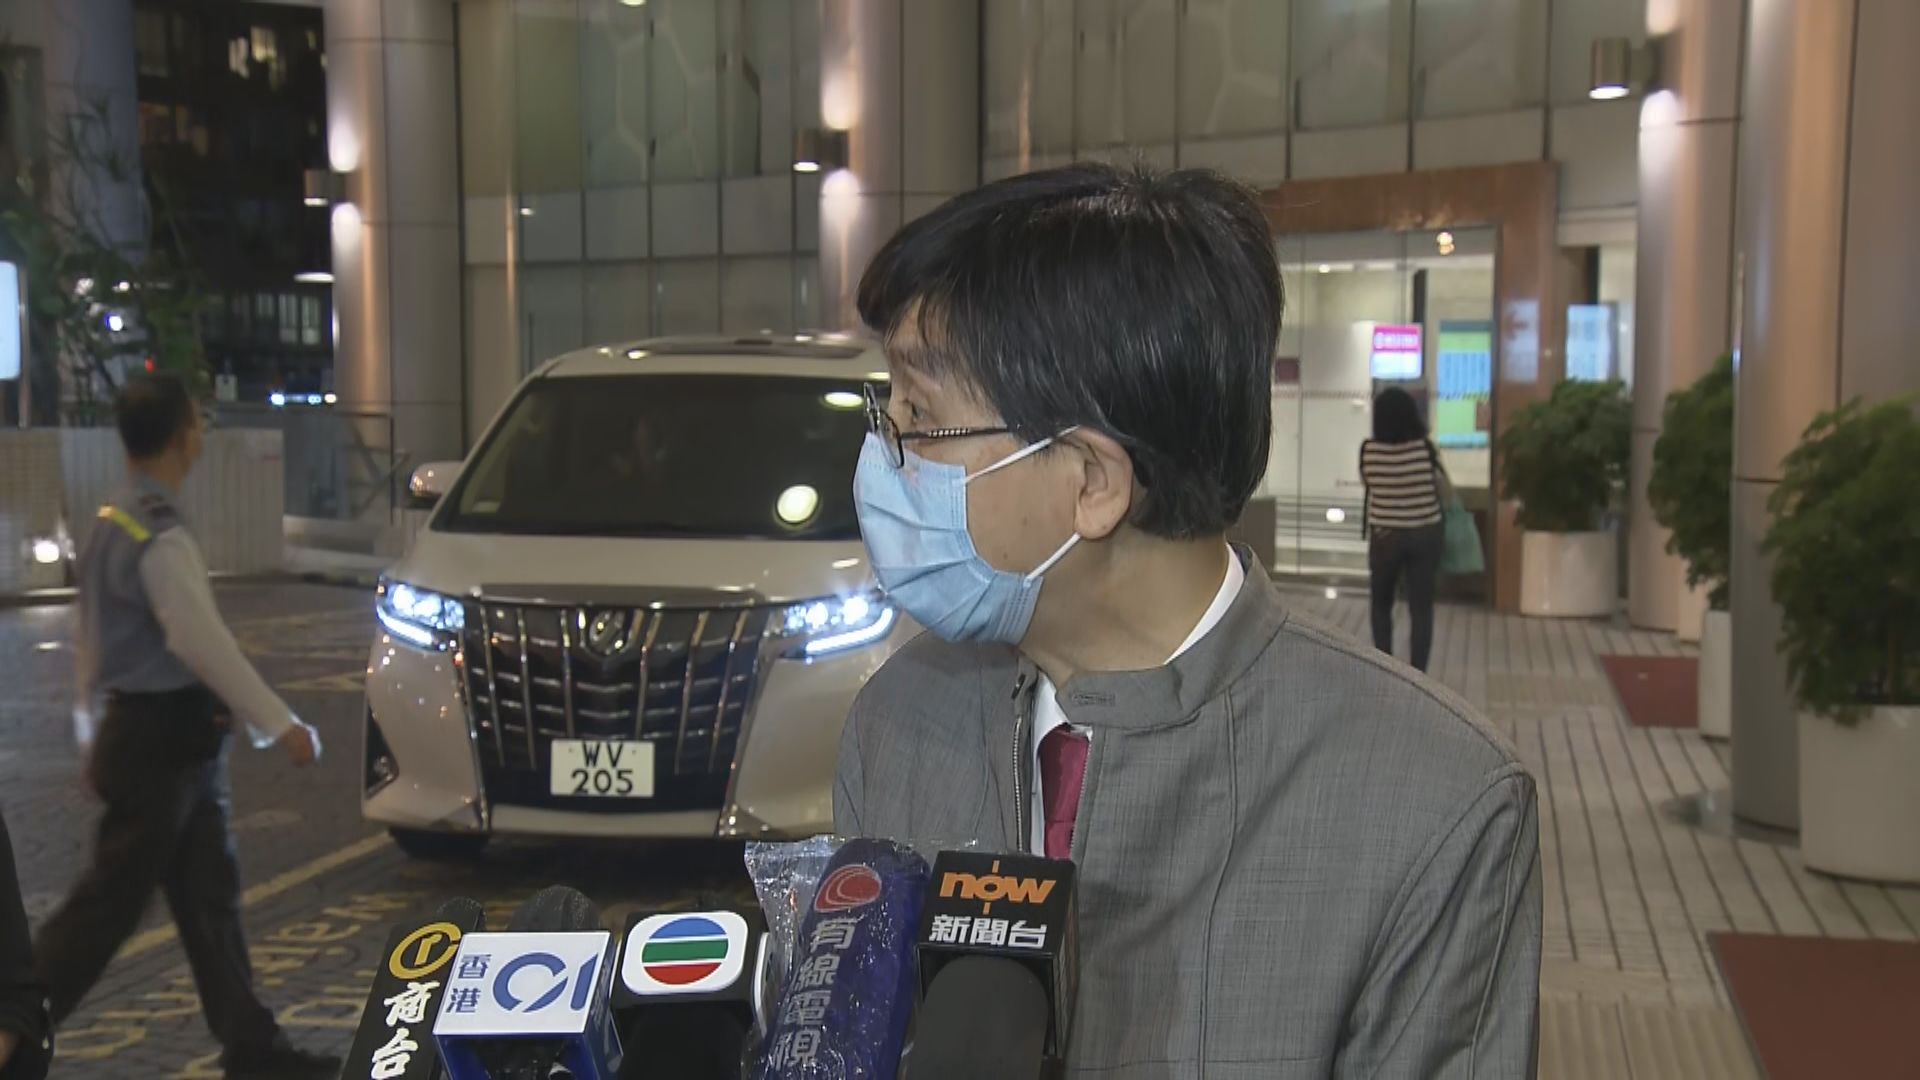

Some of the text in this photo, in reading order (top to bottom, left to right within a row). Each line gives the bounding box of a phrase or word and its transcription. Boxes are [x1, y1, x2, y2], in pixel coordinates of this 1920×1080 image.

[571, 768, 633, 794] 205
[582, 740, 624, 768] WV
[939, 860, 1056, 915] now
[928, 914, 1047, 949] 新聞台
[446, 952, 493, 1014] 香港
[767, 915, 859, 1073] 有線電視
[369, 981, 441, 1080] 商台
